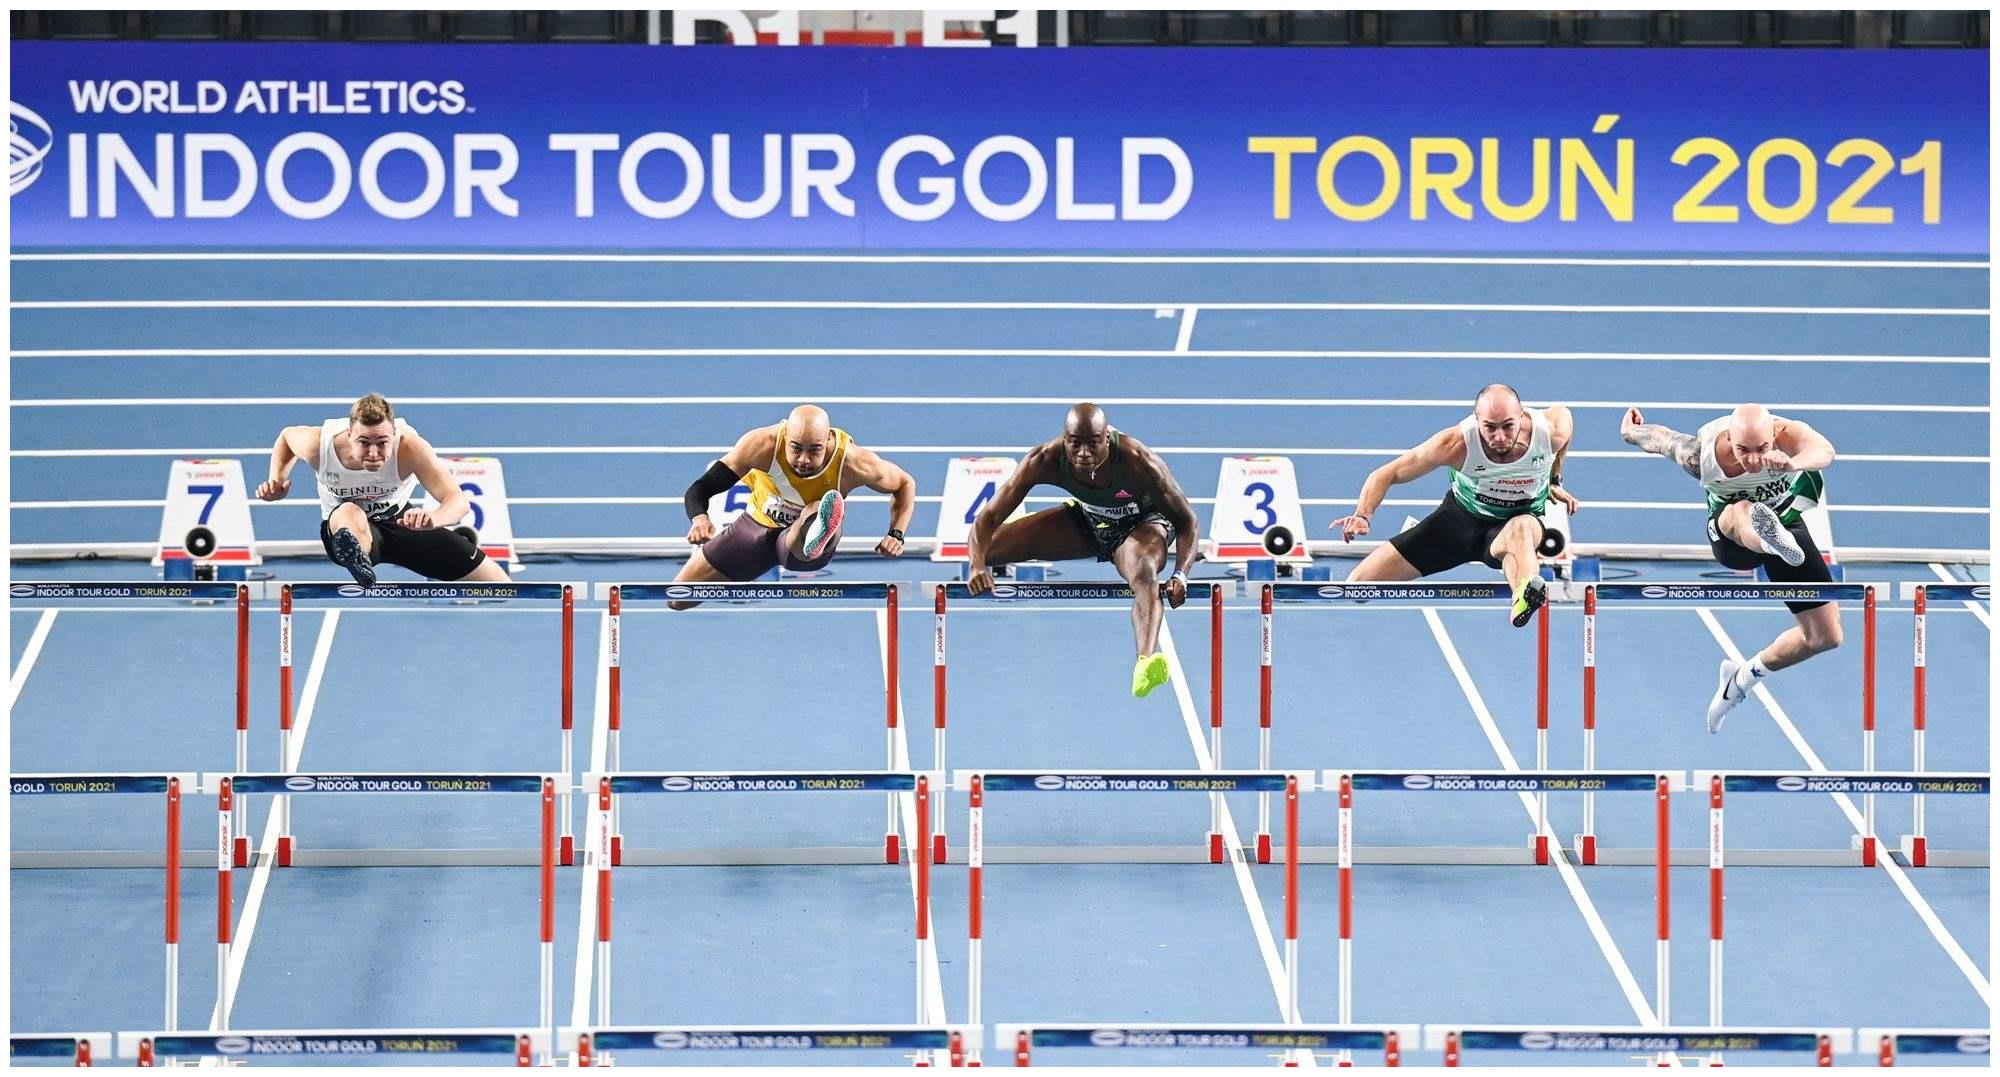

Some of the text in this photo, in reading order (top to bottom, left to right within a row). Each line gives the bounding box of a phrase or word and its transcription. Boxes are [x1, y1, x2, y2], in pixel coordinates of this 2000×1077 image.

[68, 80, 466, 114] WORLD ATHLETICS
[69, 114, 1941, 224] INDOOR TOUR GOLD TORUŃ 2021
[187, 485, 223, 525] 7
[1243, 482, 1277, 534] 3
[36, 586, 192, 597] INDOOR TOUR GOLD TORUŃ 2021
[365, 588, 402, 597] INDOOR
[404, 588, 429, 597] TOUR
[431, 588, 457, 597] GOLD
[461, 587, 492, 596] TORUŃ
[693, 590, 729, 598] INDOOR
[731, 590, 756, 598] TOUR
[758, 590, 783, 598] GOLD
[787, 587, 819, 597] TORUŃ
[1018, 590, 1054, 598] INDOOR
[1056, 590, 1081, 598] TOUR
[1082, 590, 1107, 598] GOLD
[1344, 590, 1380, 598] INDOOR
[1382, 590, 1408, 598] TOUR
[1408, 590, 1435, 598] GOLD
[1439, 587, 1470, 597] TORUŃ
[1668, 588, 1820, 598] INDOOR TOUR GOLD TORUŃ 2021
[13, 784, 45, 792] GOLD
[89, 782, 115, 791] 2021
[317, 781, 359, 790] INDOOR
[361, 781, 390, 790] TOUR
[391, 781, 422, 790] GOLD
[465, 781, 491, 790] 2021
[693, 780, 735, 790] INDOOR
[737, 780, 765, 790] TOUR
[767, 780, 797, 790] GOLD
[839, 780, 865, 789] 2021
[1066, 780, 1107, 790] INDOOR
[1109, 780, 1137, 790] TOUR
[1138, 780, 1168, 790] GOLD
[1210, 780, 1236, 790] 2021
[1434, 780, 1476, 790] INDOOR
[1477, 780, 1506, 790] TOUR
[1507, 780, 1538, 790] GOLD
[1808, 782, 1850, 792] INDOOR
[1852, 782, 1881, 792] TOUR
[1882, 782, 1913, 792] GOLD
